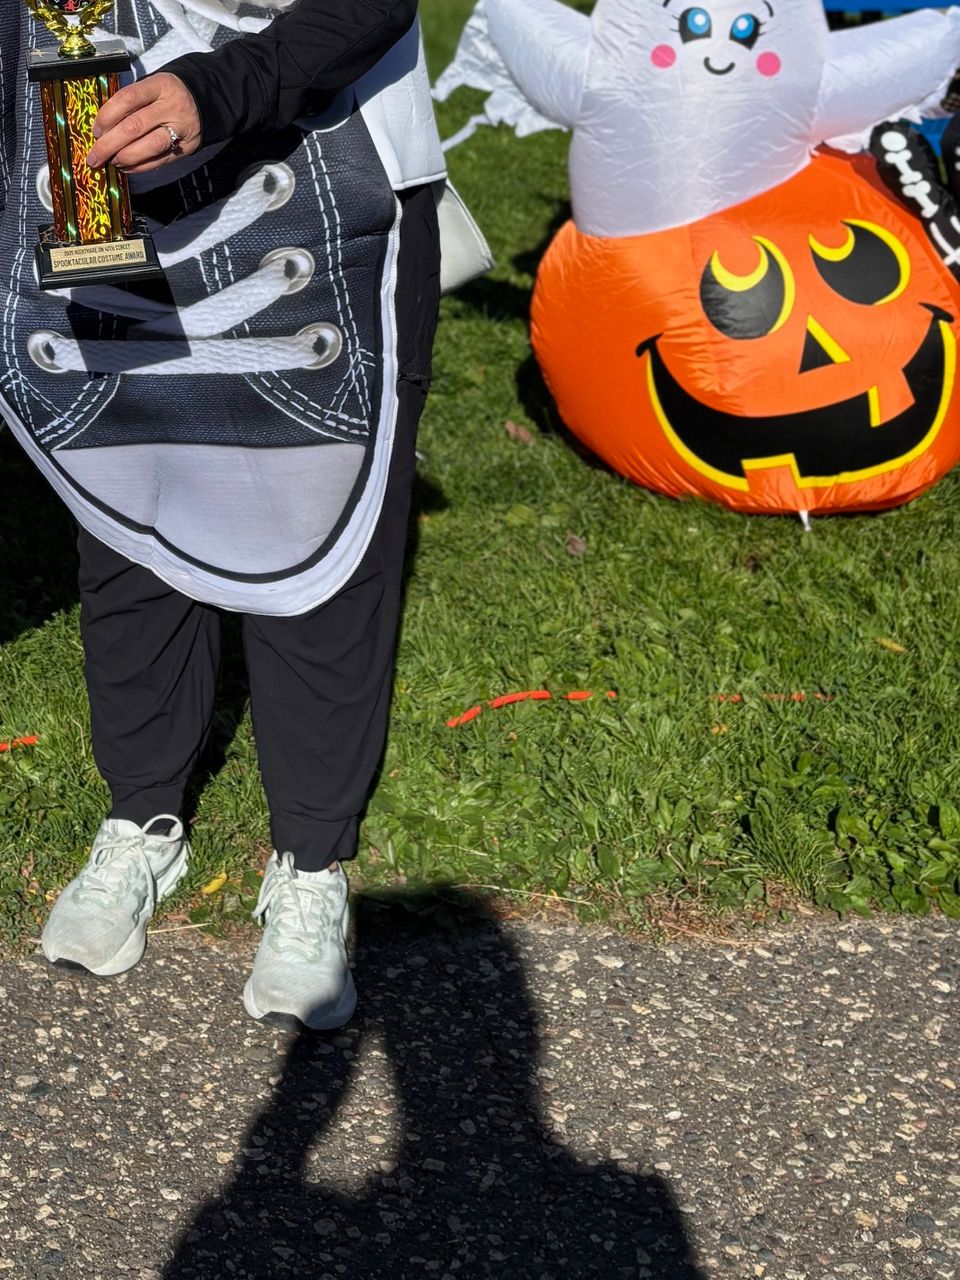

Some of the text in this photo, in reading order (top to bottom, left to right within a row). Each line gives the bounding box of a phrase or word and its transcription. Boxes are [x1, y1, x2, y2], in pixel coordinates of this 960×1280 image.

[53, 251, 144, 268] SPOOKTACULAR COSTUME AWARD
